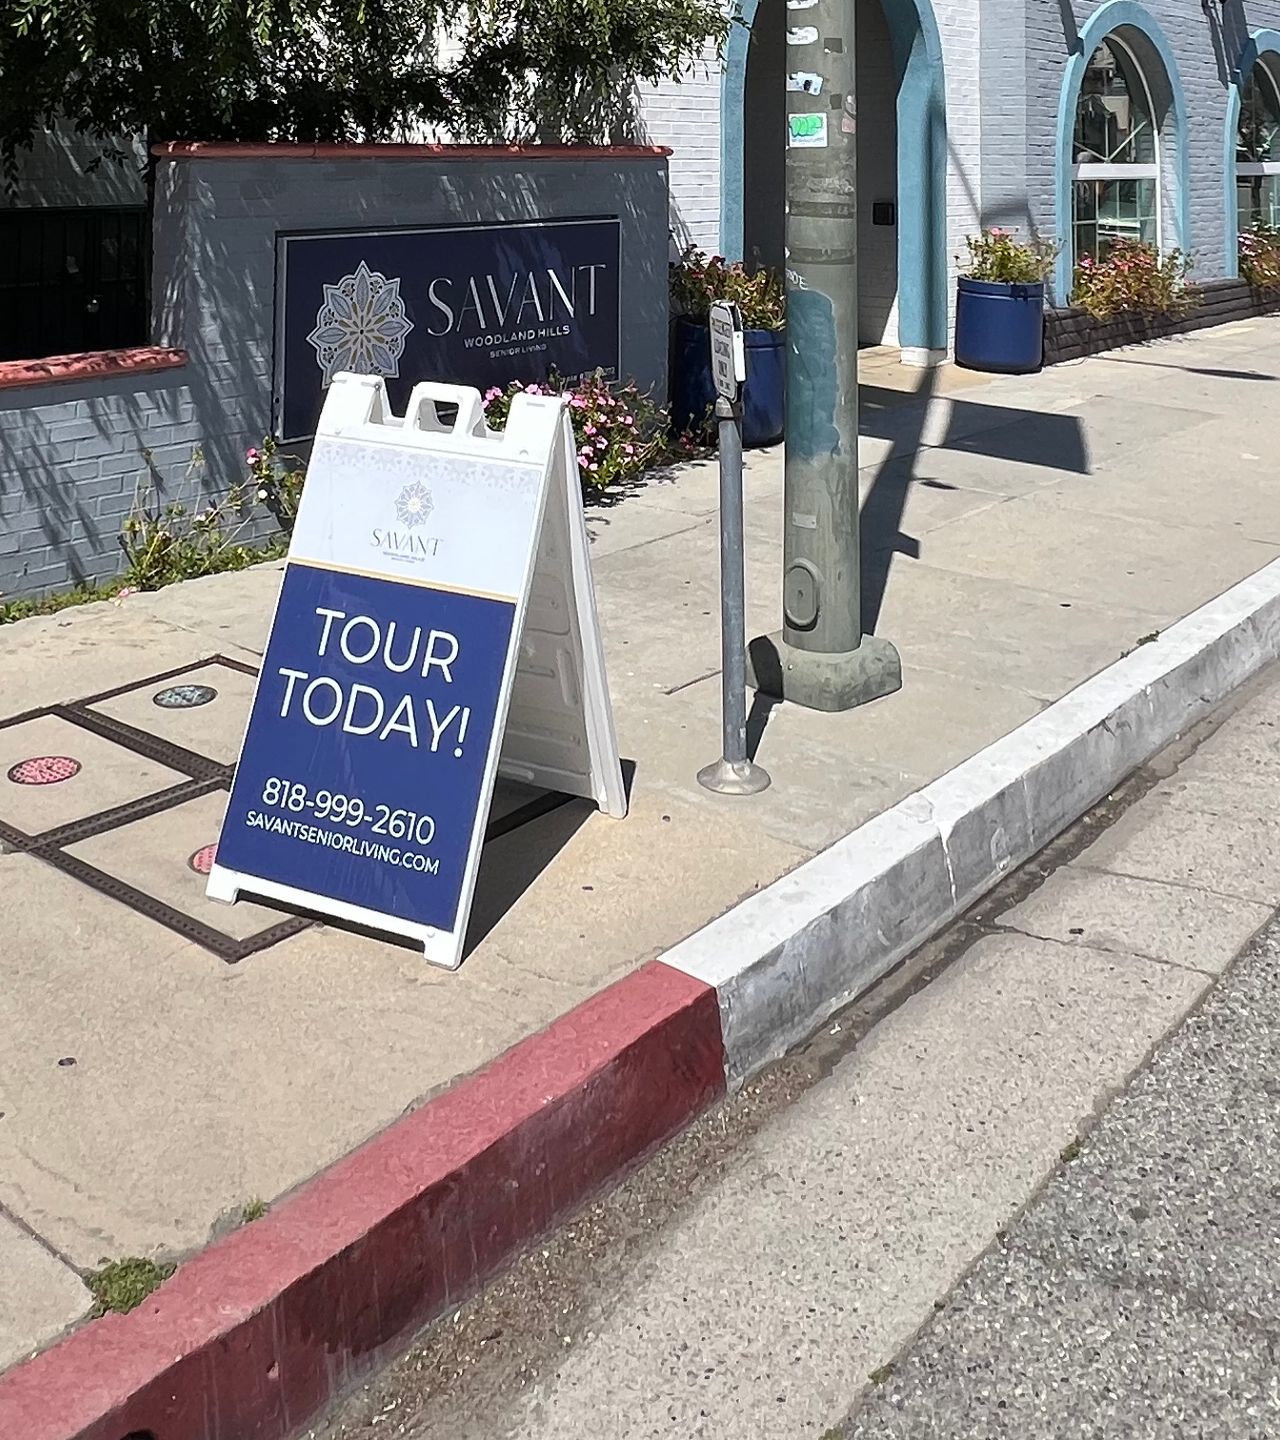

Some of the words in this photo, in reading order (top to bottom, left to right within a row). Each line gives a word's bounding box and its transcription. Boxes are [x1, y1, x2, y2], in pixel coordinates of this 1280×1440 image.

[426, 263, 607, 337] SAVANT
[463, 329, 536, 349] WOODLAND
[537, 324, 571, 338] HILLS
[489, 346, 520, 359] SENIOR
[370, 528, 445, 556] SAVANT
[315, 607, 460, 683] TOUR
[277, 667, 472, 758] TODAY!
[245, 809, 441, 877] SAVANTSENIORLIVING.COM
[261, 776, 435, 846] 818-999-2610
